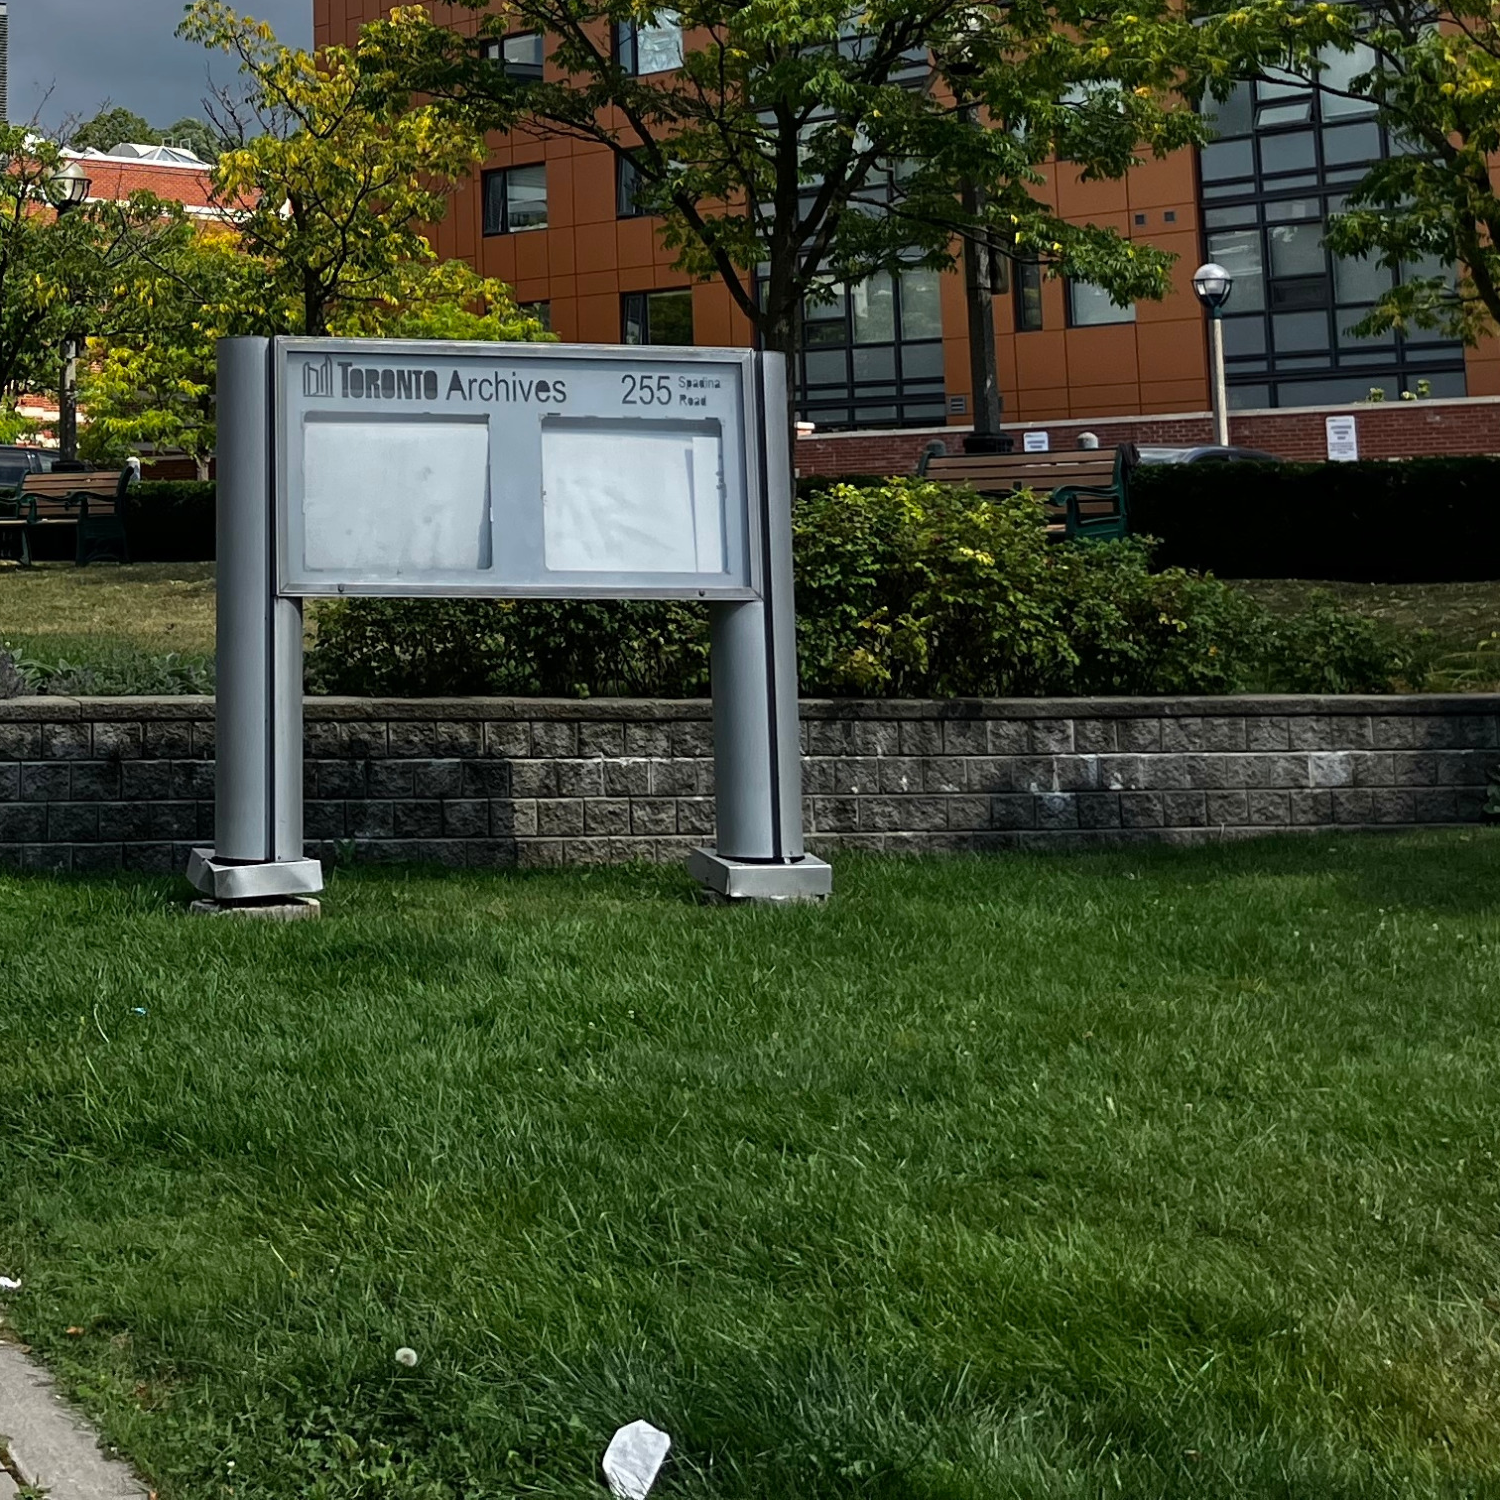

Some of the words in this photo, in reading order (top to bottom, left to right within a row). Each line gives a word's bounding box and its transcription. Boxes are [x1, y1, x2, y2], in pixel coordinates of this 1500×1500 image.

[338, 361, 438, 400] TORONTO
[446, 370, 567, 403] Archives
[621, 374, 672, 405] 255
[678, 376, 721, 390] Spadina
[679, 394, 707, 406] Road
